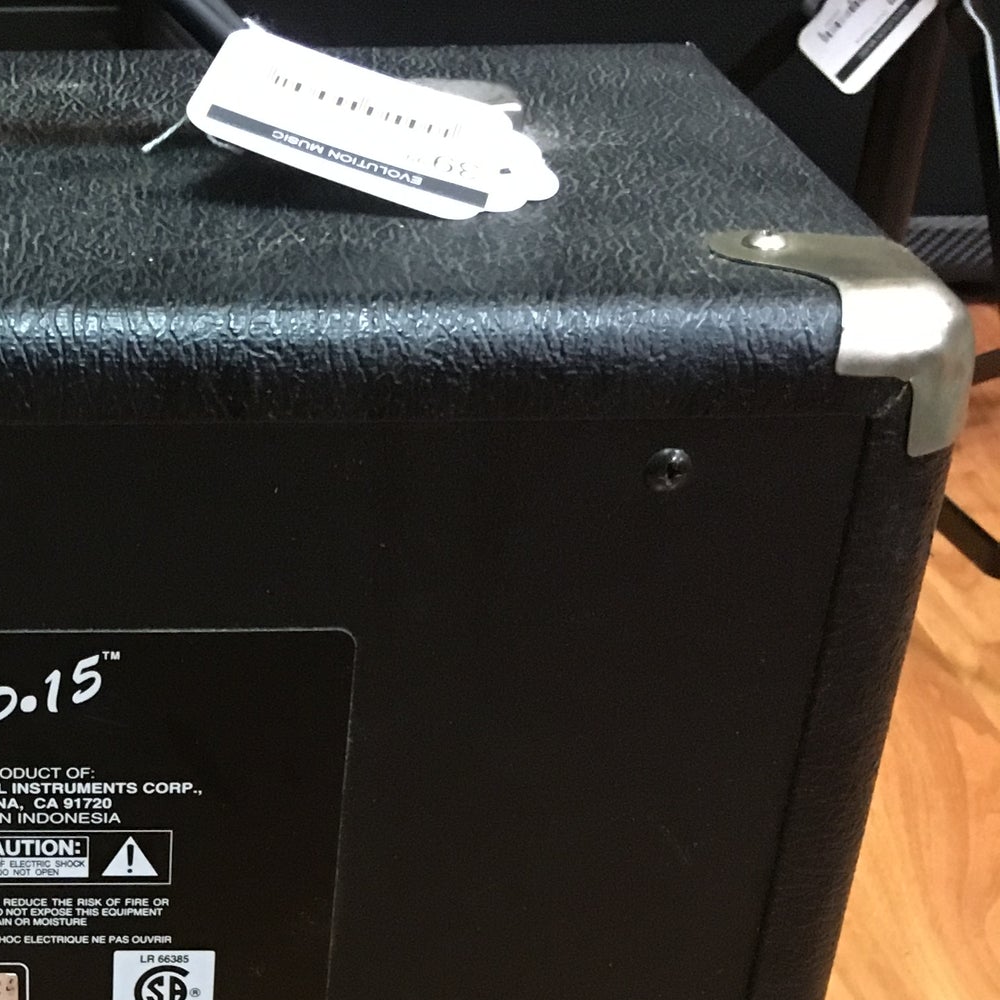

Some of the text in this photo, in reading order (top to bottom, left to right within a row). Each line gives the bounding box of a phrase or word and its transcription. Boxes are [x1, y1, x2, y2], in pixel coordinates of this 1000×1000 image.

[271, 129, 423, 186] EVOLUTION MUSIC
[65, 766, 95, 780] OF:
[11, 781, 138, 795] INSTRUMENTS
[142, 781, 203, 796] CORP.,
[33, 797, 59, 810] CA
[63, 797, 113, 810] 91720
[17, 811, 122, 825] INDONESIA
[9, 859, 51, 869] ELECTRIC
[54, 859, 86, 868] SHOCK
[12, 868, 31, 877] NOT
[34, 868, 60, 877] OPEN
[2, 897, 48, 907] REDUCE
[51, 897, 73, 907] THE
[76, 897, 103, 907] RISK
[105, 897, 122, 907] OF
[124, 897, 150, 907] FIRE
[152, 897, 170, 907] OR
[5, 907, 29, 917] NOT
[29, 907, 73, 917] EXPOSE
[74, 907, 100, 917] THIS
[101, 907, 164, 917] EQUIPMENT
[13, 917, 31, 927] OR
[32, 917, 88, 927] MOISTURE
[23, 935, 90, 944] ELECTRIQUE
[91, 935, 107, 944] NE
[108, 935, 130, 944] PAS
[131, 935, 172, 944] OUVRIR
[139, 954, 190, 964] LR 66385
